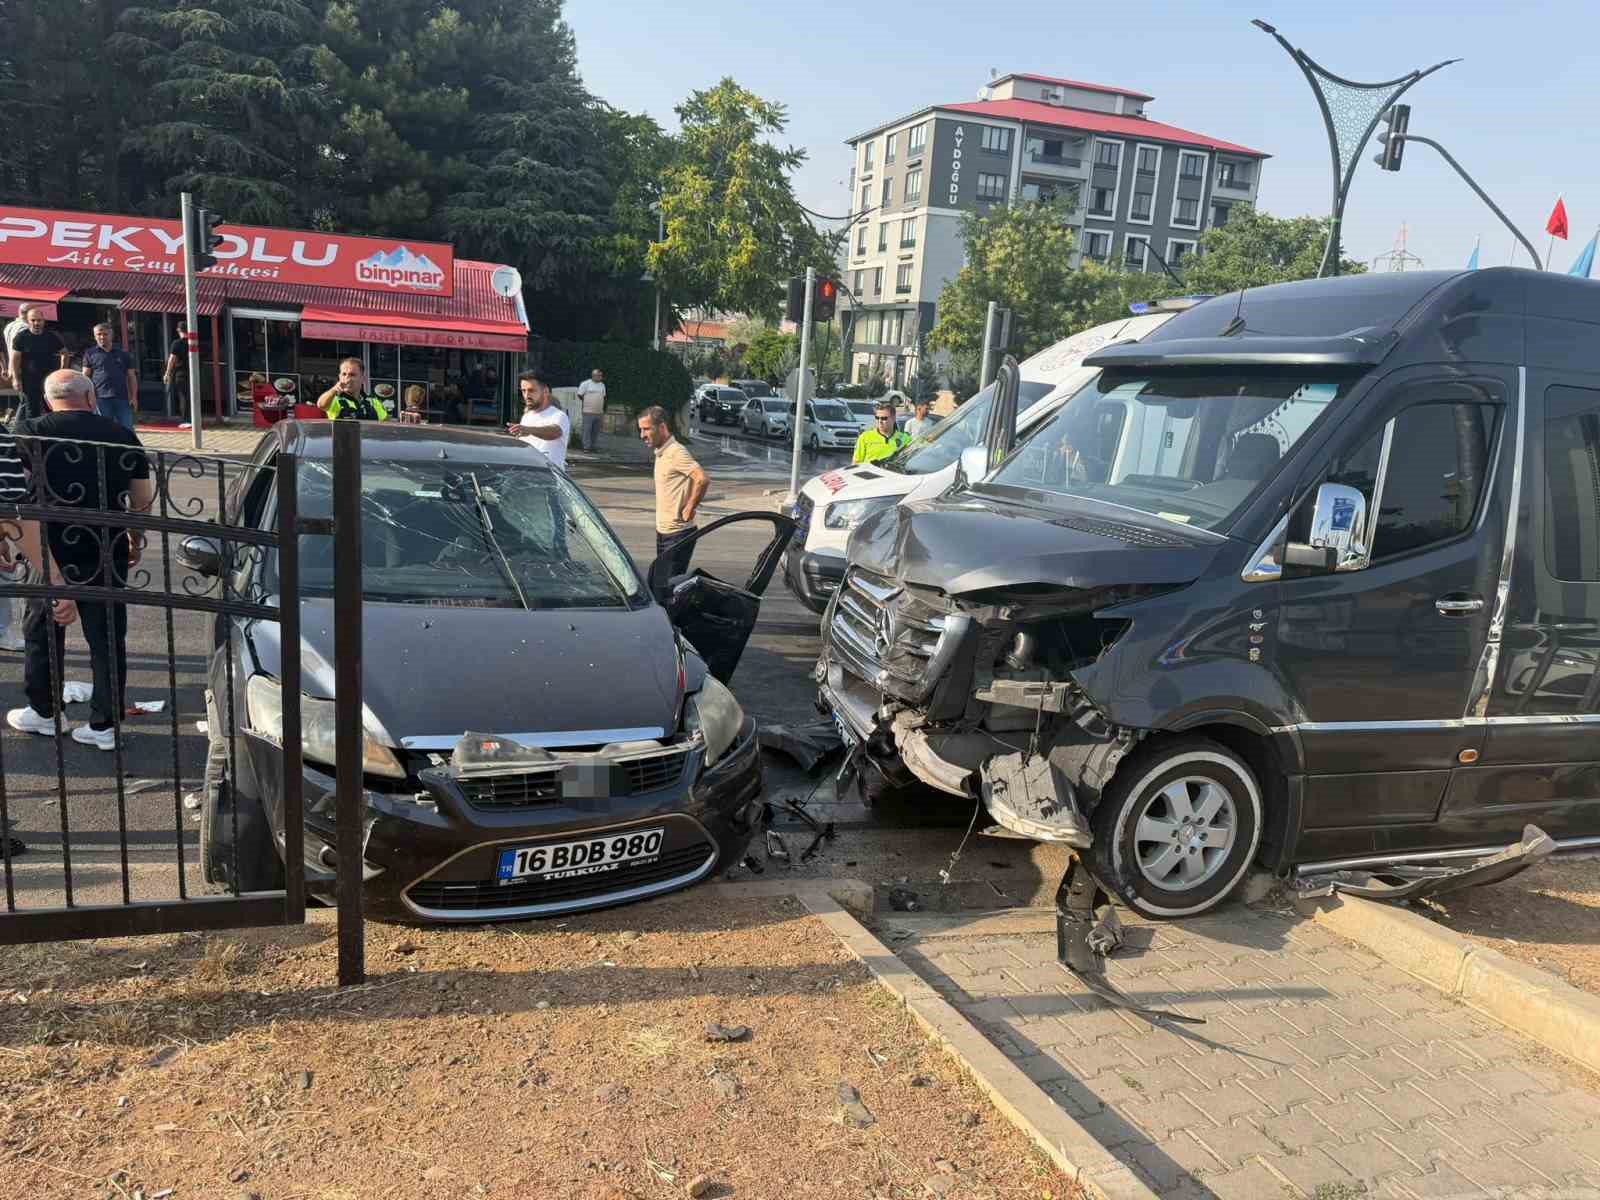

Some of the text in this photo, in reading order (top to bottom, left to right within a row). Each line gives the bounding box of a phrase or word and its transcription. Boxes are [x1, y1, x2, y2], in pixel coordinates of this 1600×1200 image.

[949, 126, 964, 204] AYDOĞDU
[47, 251, 280, 279] Aile Çay ahçesi
[517, 832, 660, 873] 16 BDB 980
[543, 862, 619, 880] TURKUAZ
